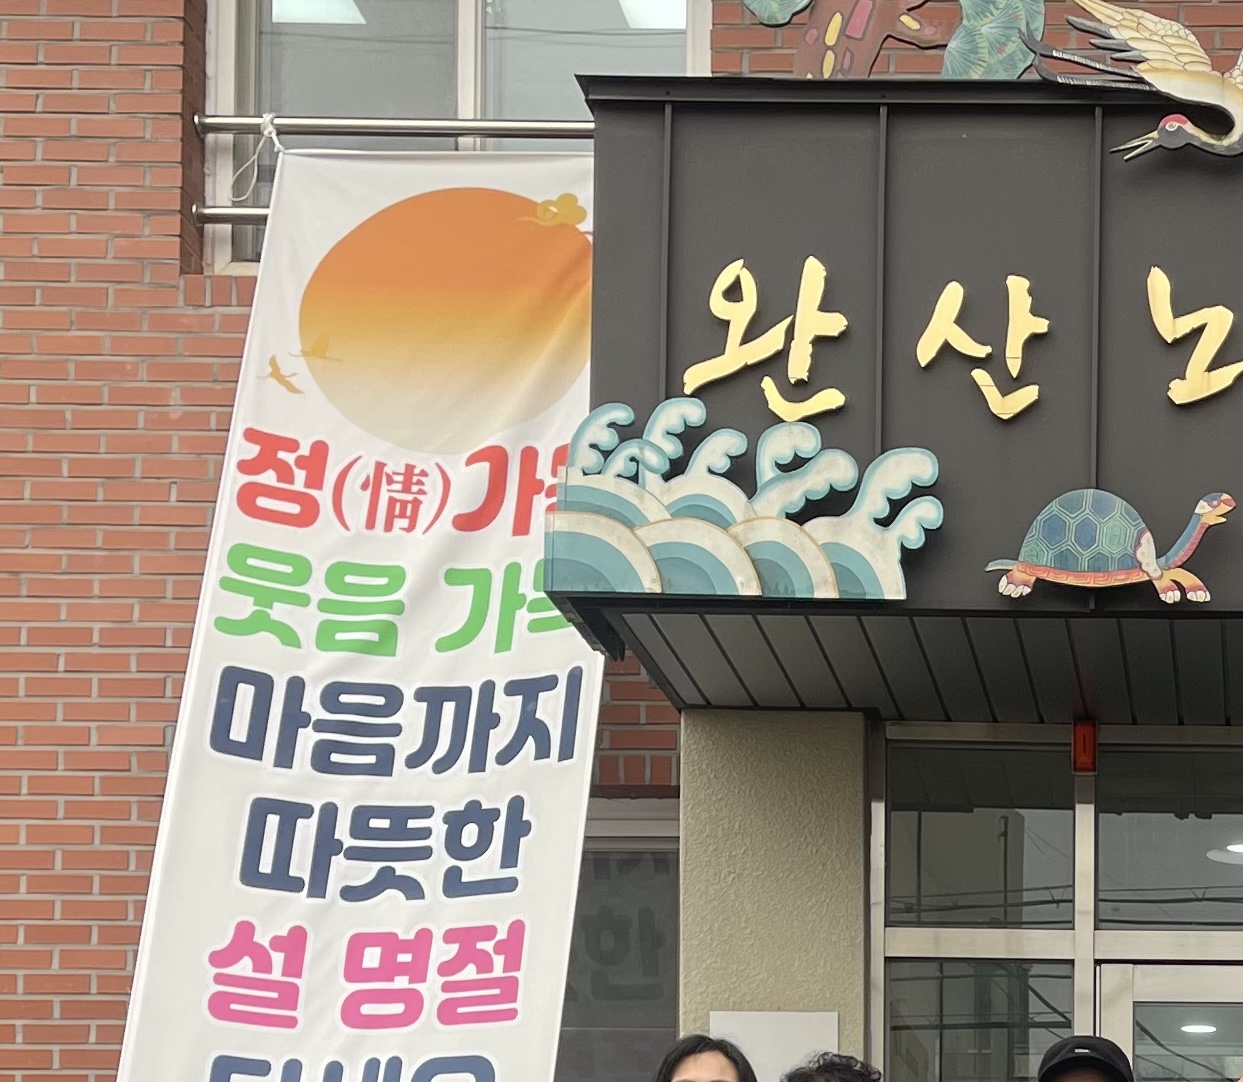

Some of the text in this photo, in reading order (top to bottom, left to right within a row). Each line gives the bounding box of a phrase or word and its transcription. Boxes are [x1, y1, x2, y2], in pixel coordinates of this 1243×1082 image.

[214, 543, 406, 657] 웃음
[210, 666, 583, 776] 마음까지
[240, 795, 532, 901] 따뜻한
[208, 919, 525, 1029] 설 명절
